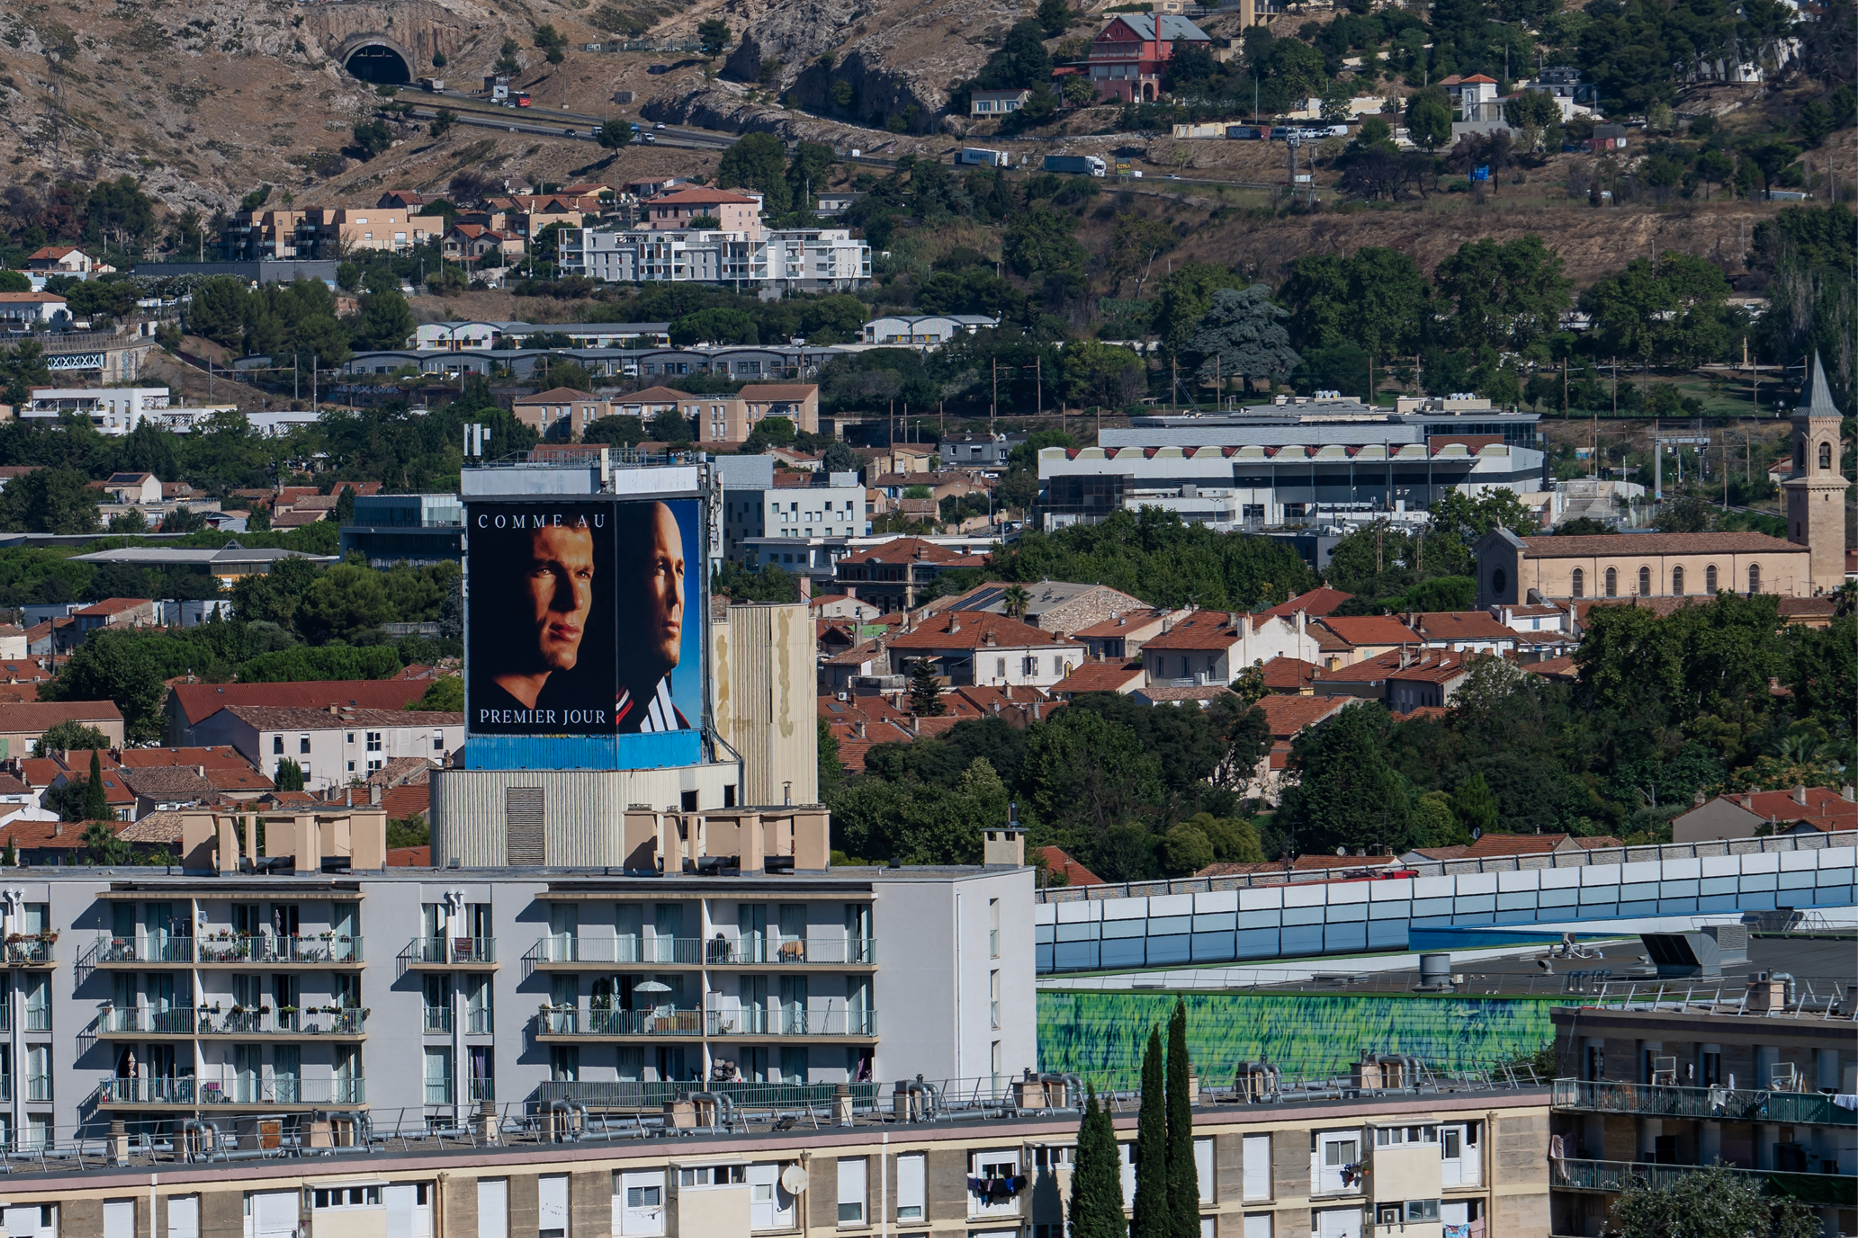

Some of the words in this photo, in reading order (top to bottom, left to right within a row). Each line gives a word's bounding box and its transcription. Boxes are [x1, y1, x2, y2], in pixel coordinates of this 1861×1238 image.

[478, 514, 563, 529] COMME
[576, 514, 606, 529] AU
[479, 708, 557, 724] PREMIER
[562, 708, 606, 725] JOUR
